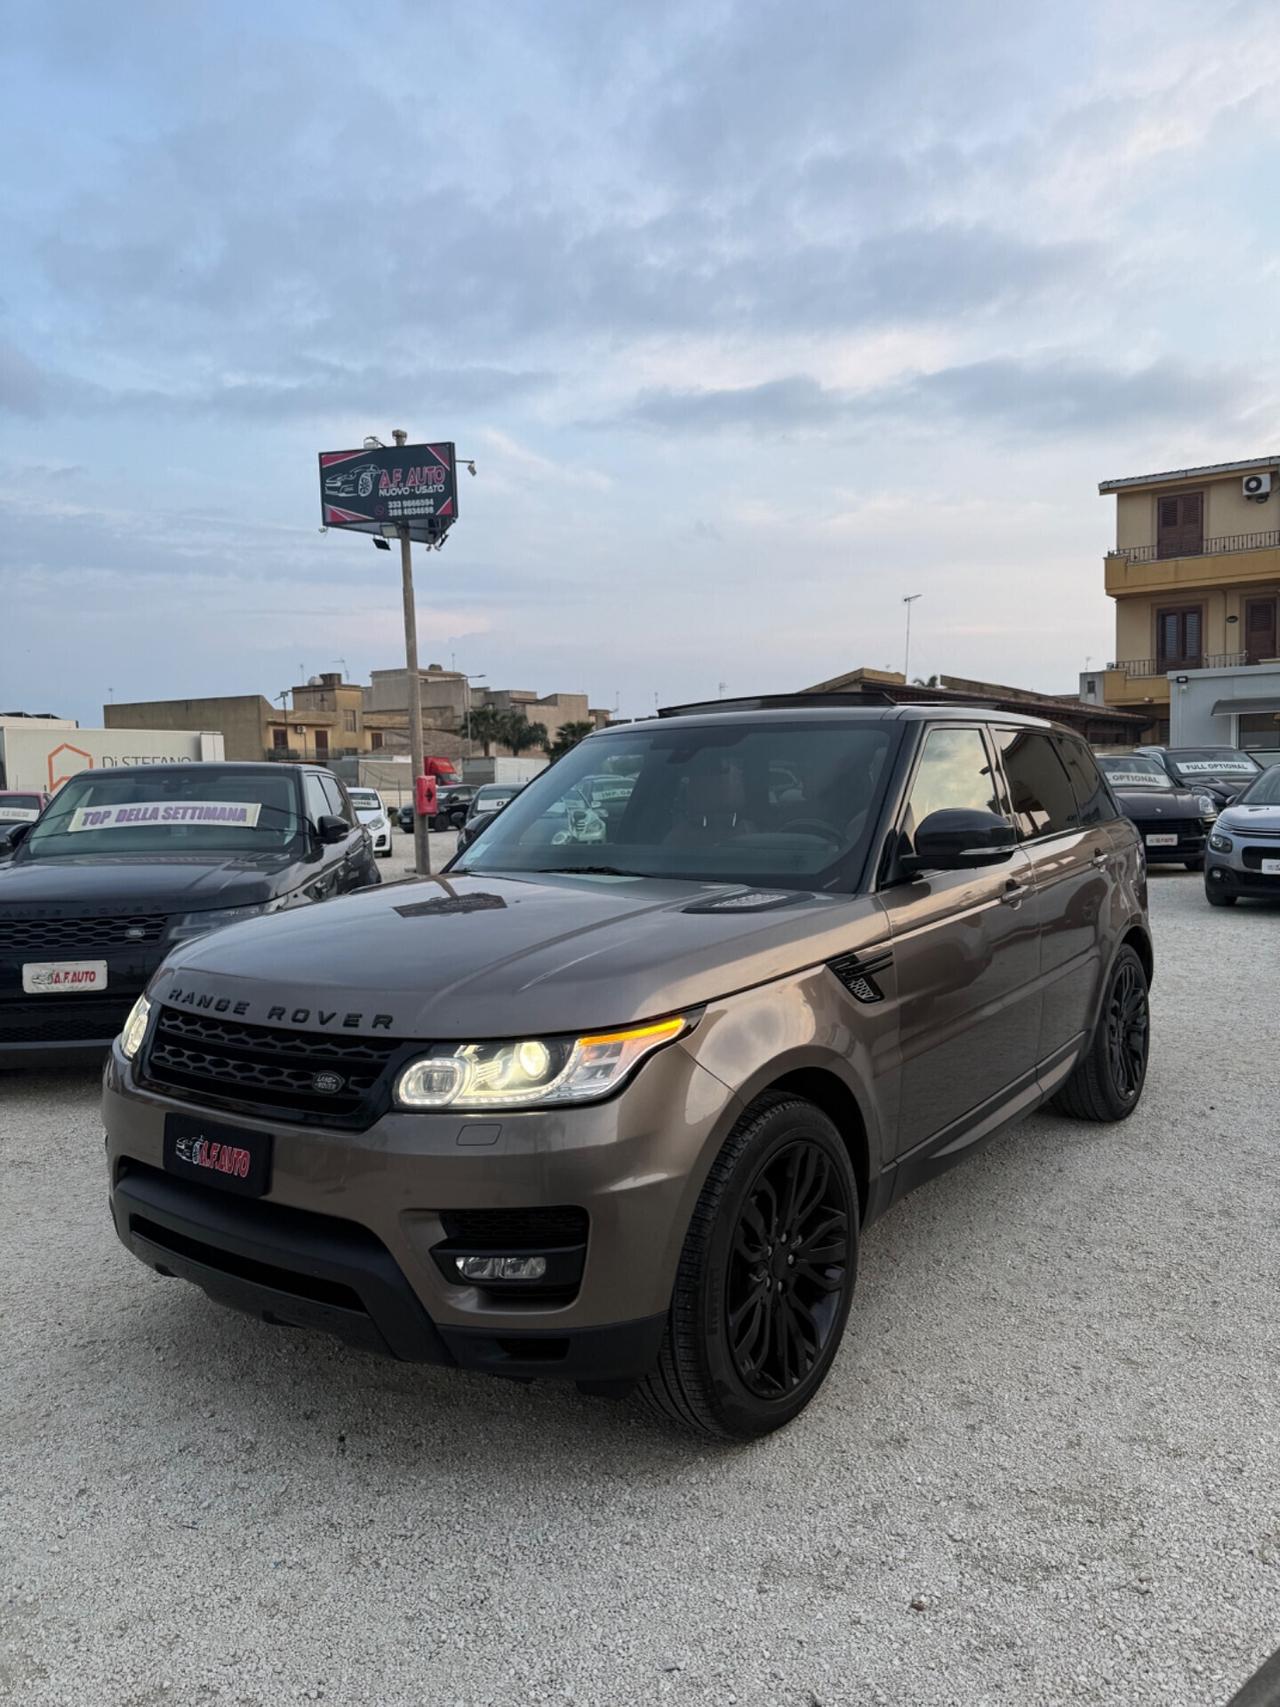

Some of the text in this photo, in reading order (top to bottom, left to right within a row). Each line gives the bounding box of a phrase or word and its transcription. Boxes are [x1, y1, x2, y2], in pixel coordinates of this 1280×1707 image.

[406, 466, 445, 487] AUTO
[378, 484, 445, 497] NUOVO USATO
[1112, 774, 1160, 784] OPTIONAL
[82, 806, 247, 826] TOP DELLA SETTIMANA
[168, 989, 394, 1030] RANGE ROVER
